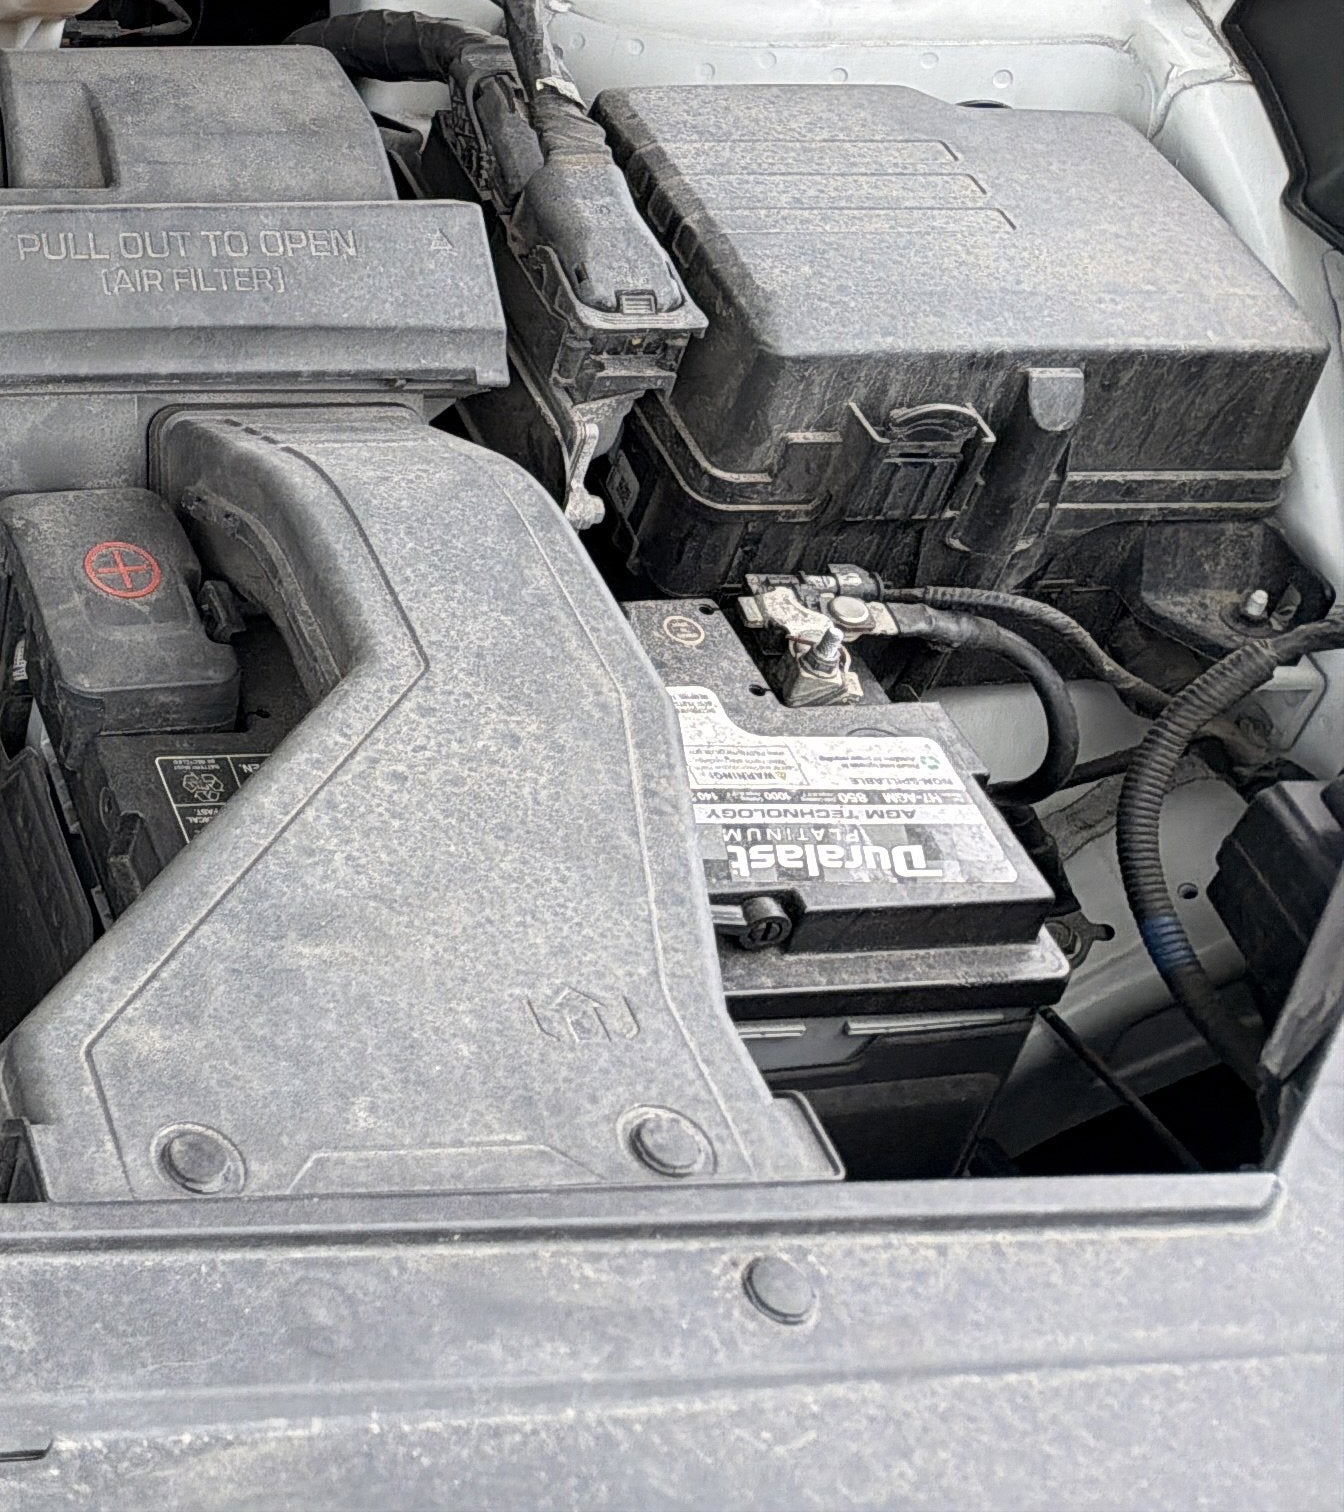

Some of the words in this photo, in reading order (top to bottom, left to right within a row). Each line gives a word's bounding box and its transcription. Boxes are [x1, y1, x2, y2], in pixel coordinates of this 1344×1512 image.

[17, 232, 111, 261] PULL
[119, 232, 191, 259] OUT
[200, 230, 249, 258] TO
[259, 229, 359, 258] OPEN
[763, 791, 791, 800] 1000
[838, 791, 868, 802] 850
[882, 791, 942, 803] H7-AGM
[706, 808, 856, 819] TECHNOLOGY
[865, 809, 916, 819] AGM
[722, 828, 866, 842] PLATINUM
[727, 844, 943, 878] Duralast
